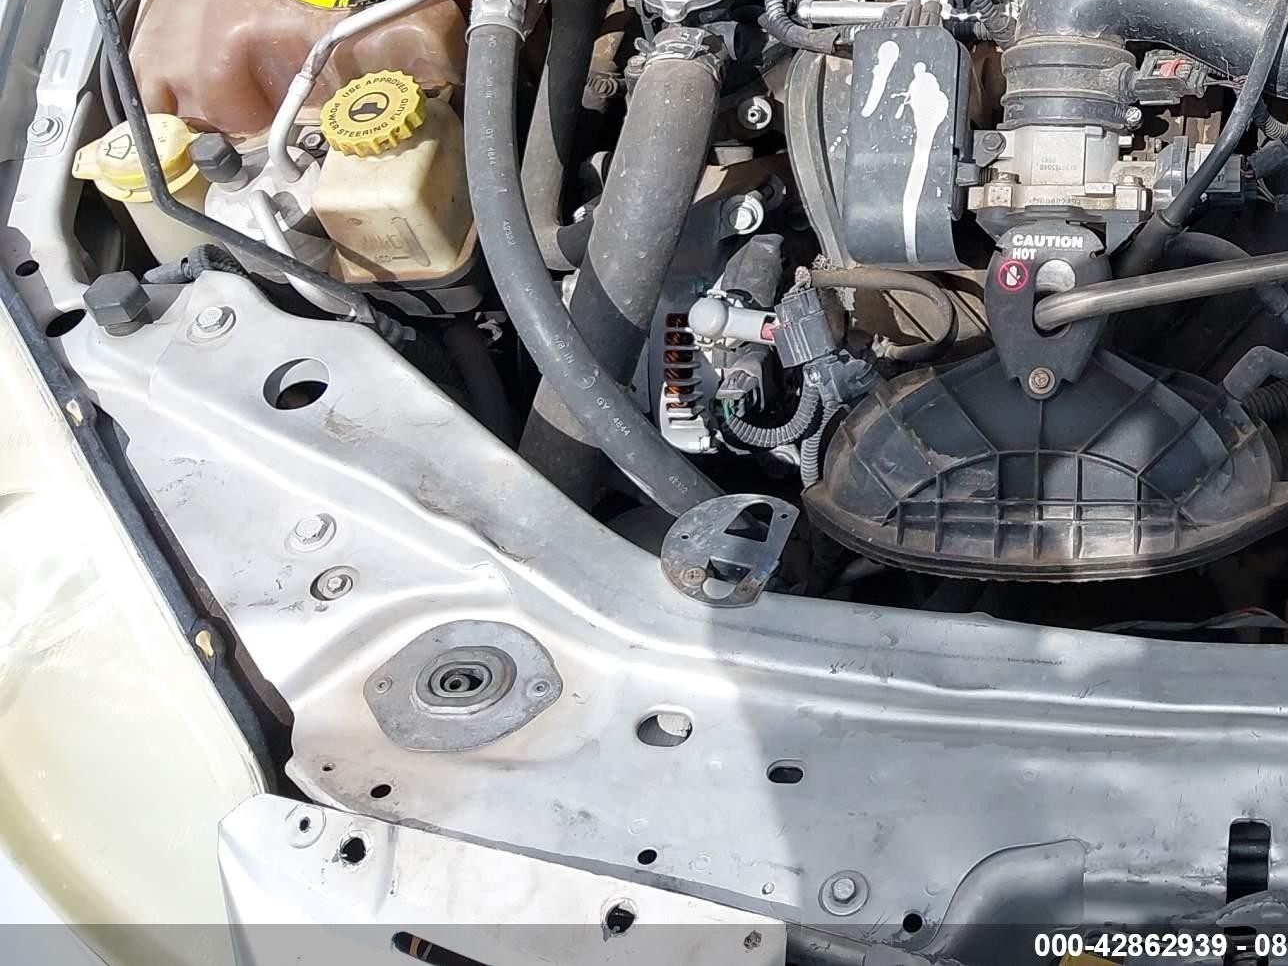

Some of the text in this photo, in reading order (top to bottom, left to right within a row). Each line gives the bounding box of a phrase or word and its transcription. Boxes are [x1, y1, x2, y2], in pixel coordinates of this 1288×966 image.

[342, 77, 409, 98] USE APPROVED
[328, 98, 409, 138] POWER STEERING FLUID
[1012, 234, 1084, 249] CAUTION
[1012, 248, 1037, 261] HOT
[596, 397, 610, 410] GY
